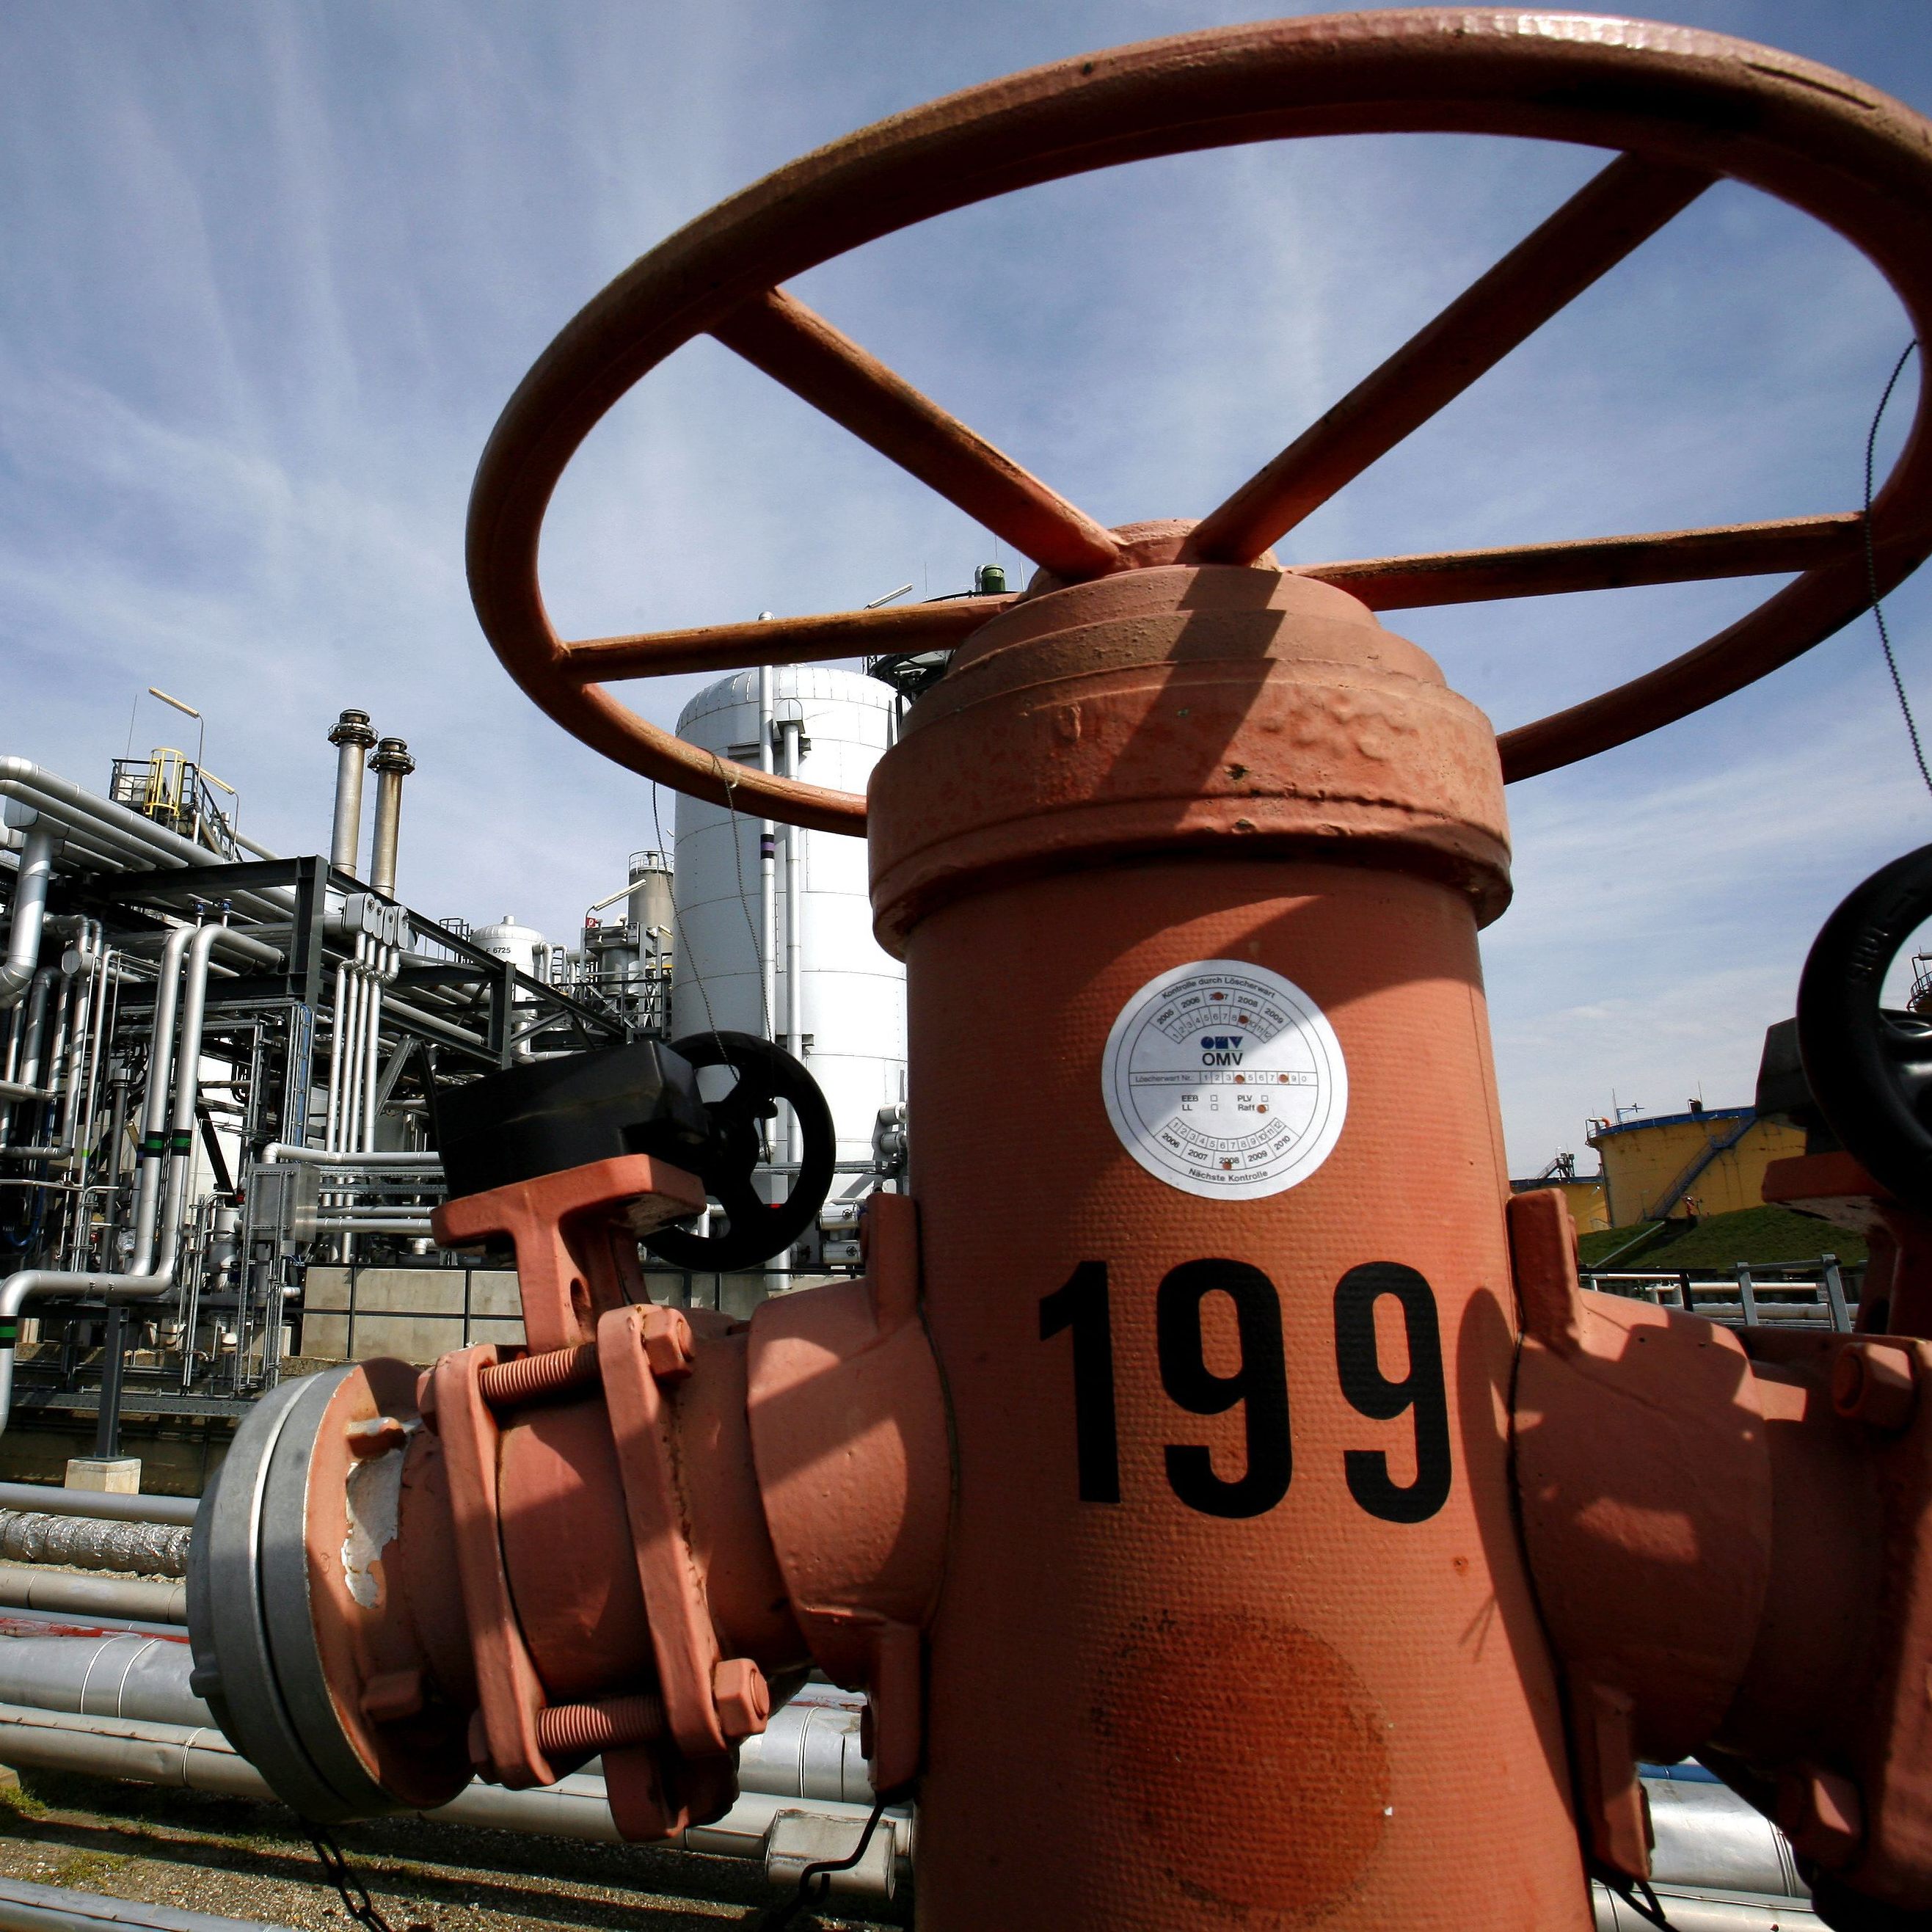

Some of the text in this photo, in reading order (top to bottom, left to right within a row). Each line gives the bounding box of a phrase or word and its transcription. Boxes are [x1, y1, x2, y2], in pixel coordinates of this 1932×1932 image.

[1162, 982, 1196, 999] Kontrolle
[1225, 977, 1275, 998] Löscherwart
[1181, 996, 1200, 1008] 2006
[1238, 996, 1258, 1007] 2008
[1265, 1008, 1283, 1024] 2009
[1203, 1053, 1243, 1065] OMV
[1188, 1150, 1208, 1161] 2007
[1248, 1151, 1267, 1162] 2009
[1274, 1136, 1290, 1150] 2010
[1189, 1169, 1268, 1182] Nächste Kontrolle
[1039, 1258, 1452, 1524] 199
